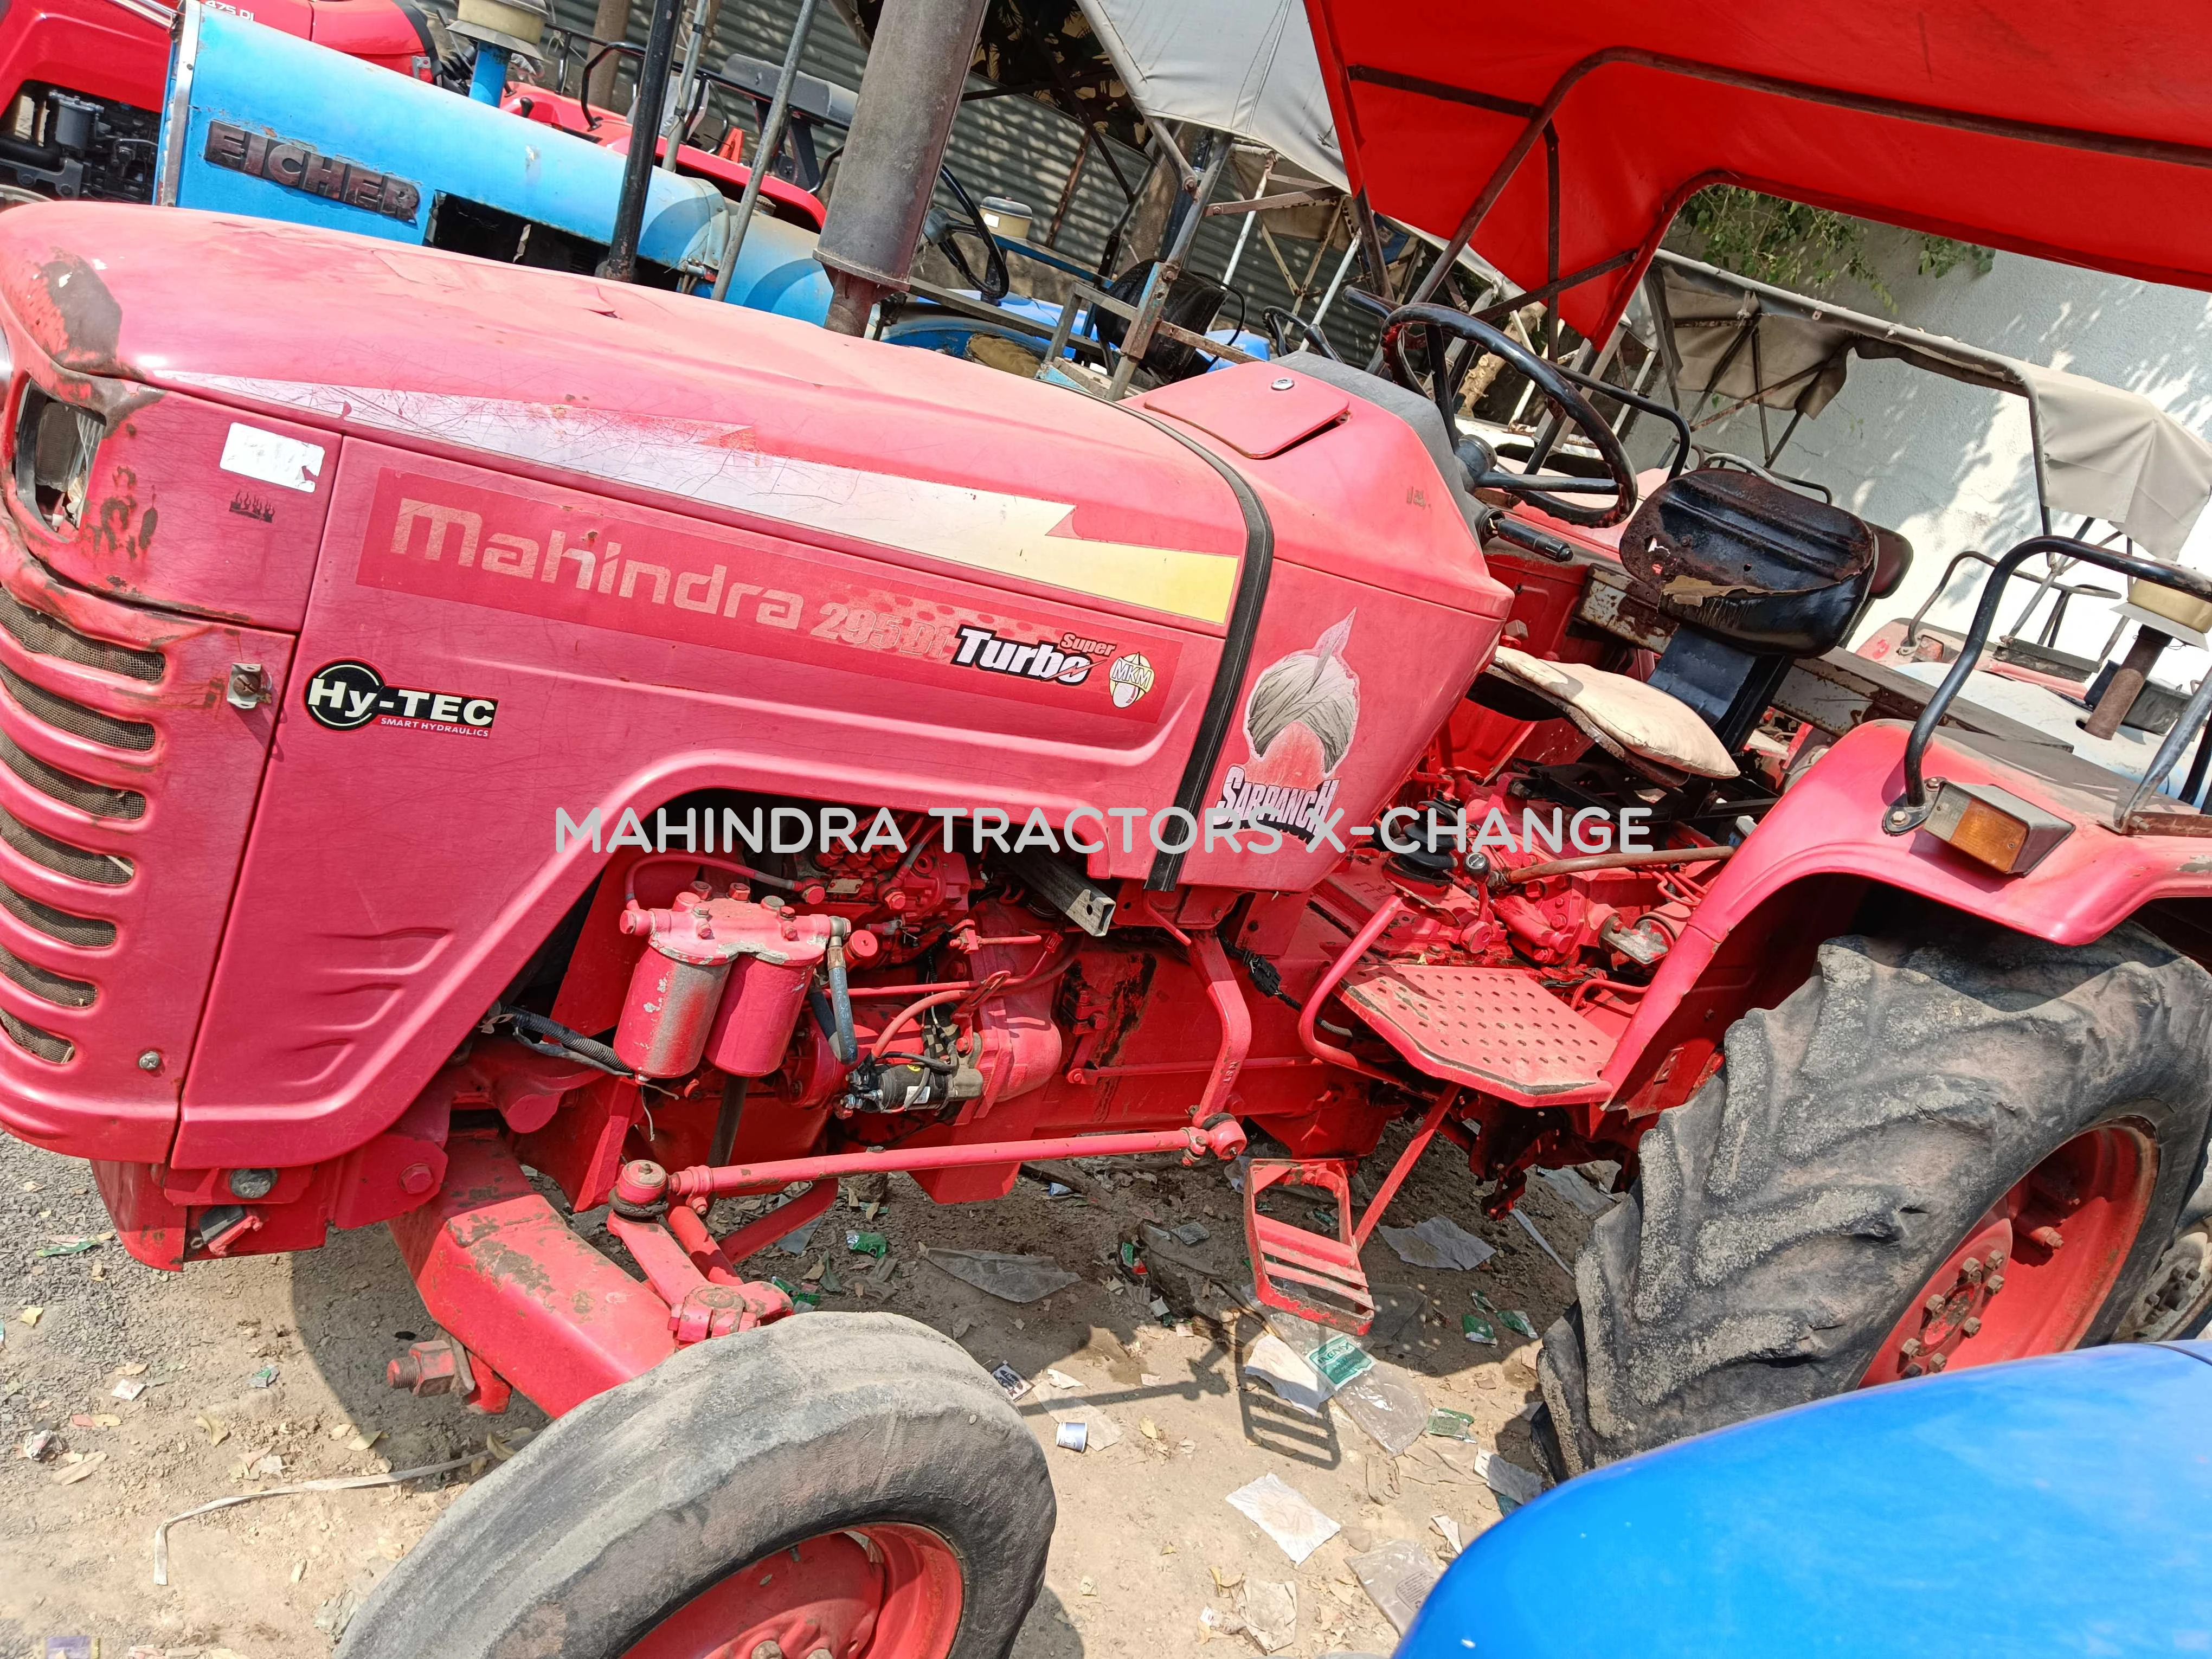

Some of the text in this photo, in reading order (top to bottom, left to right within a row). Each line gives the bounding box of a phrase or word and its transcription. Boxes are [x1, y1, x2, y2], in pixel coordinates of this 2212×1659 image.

[240, 9, 254, 22] DI
[204, 119, 420, 226] EICHER
[953, 626, 1091, 684] Turbo
[1061, 633, 1116, 657] Super
[1111, 659, 1152, 689] MKM
[308, 678, 494, 725] Hy-TEC
[381, 717, 489, 737] SMART HYDRAULICS
